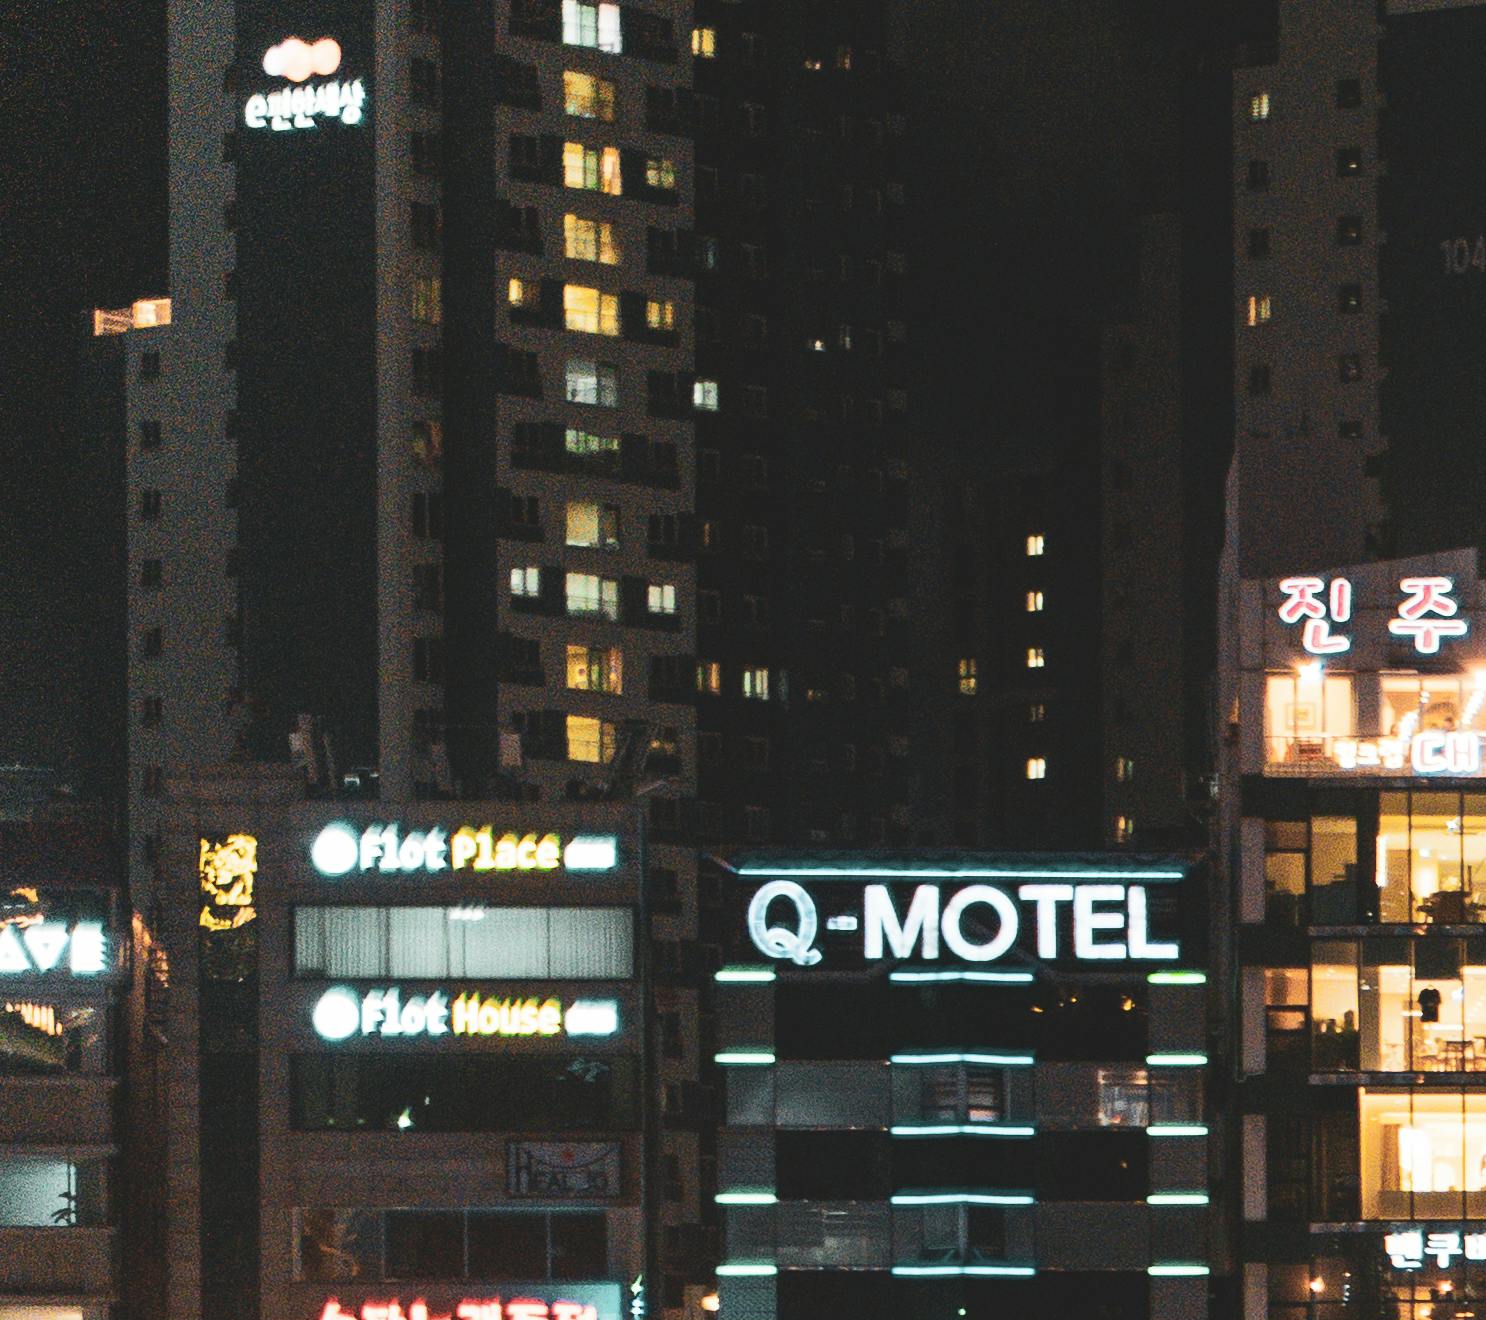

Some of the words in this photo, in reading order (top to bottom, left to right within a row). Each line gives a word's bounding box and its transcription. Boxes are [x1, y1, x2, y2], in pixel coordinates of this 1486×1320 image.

[452, 828, 560, 870] Place
[747, 879, 1180, 966] Q-MOTEL
[452, 993, 561, 1035] House
